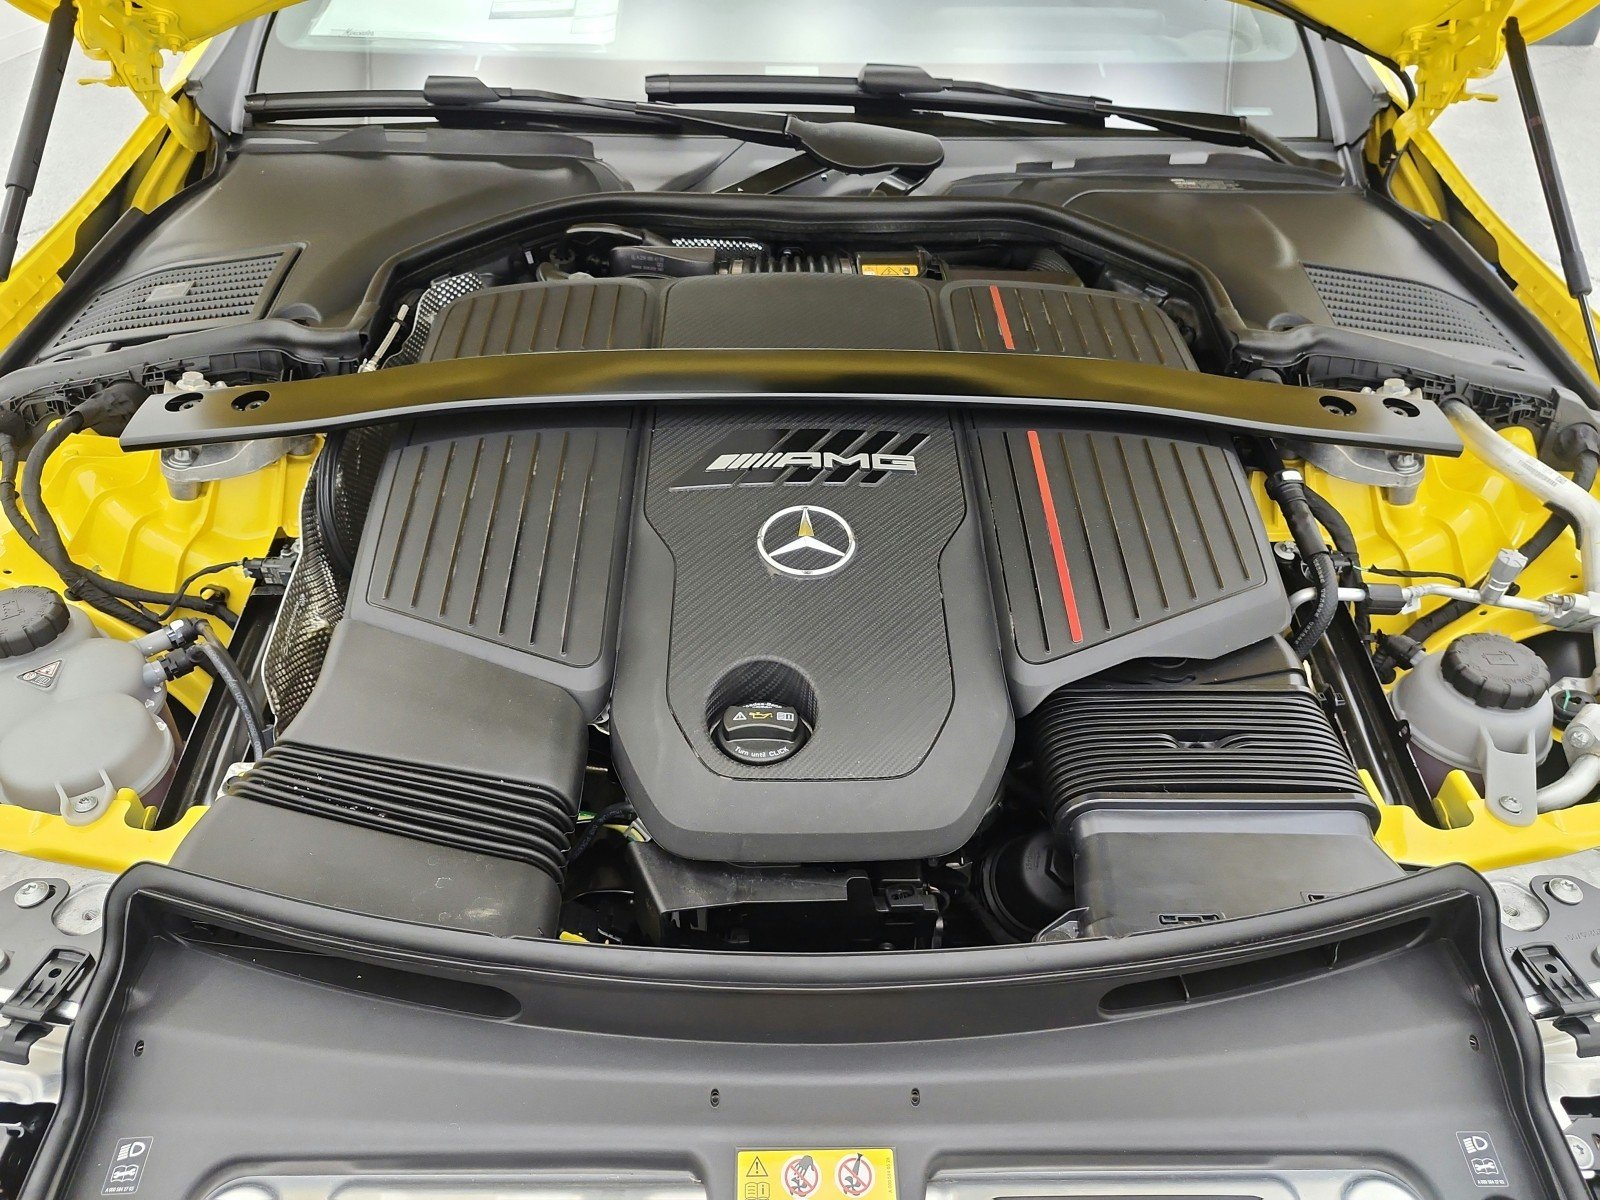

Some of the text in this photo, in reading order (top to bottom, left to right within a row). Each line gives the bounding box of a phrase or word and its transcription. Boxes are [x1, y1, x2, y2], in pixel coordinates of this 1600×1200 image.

[772, 451, 917, 475] AMG
[735, 745, 749, 756] Turn
[768, 746, 790, 757] CLICK
